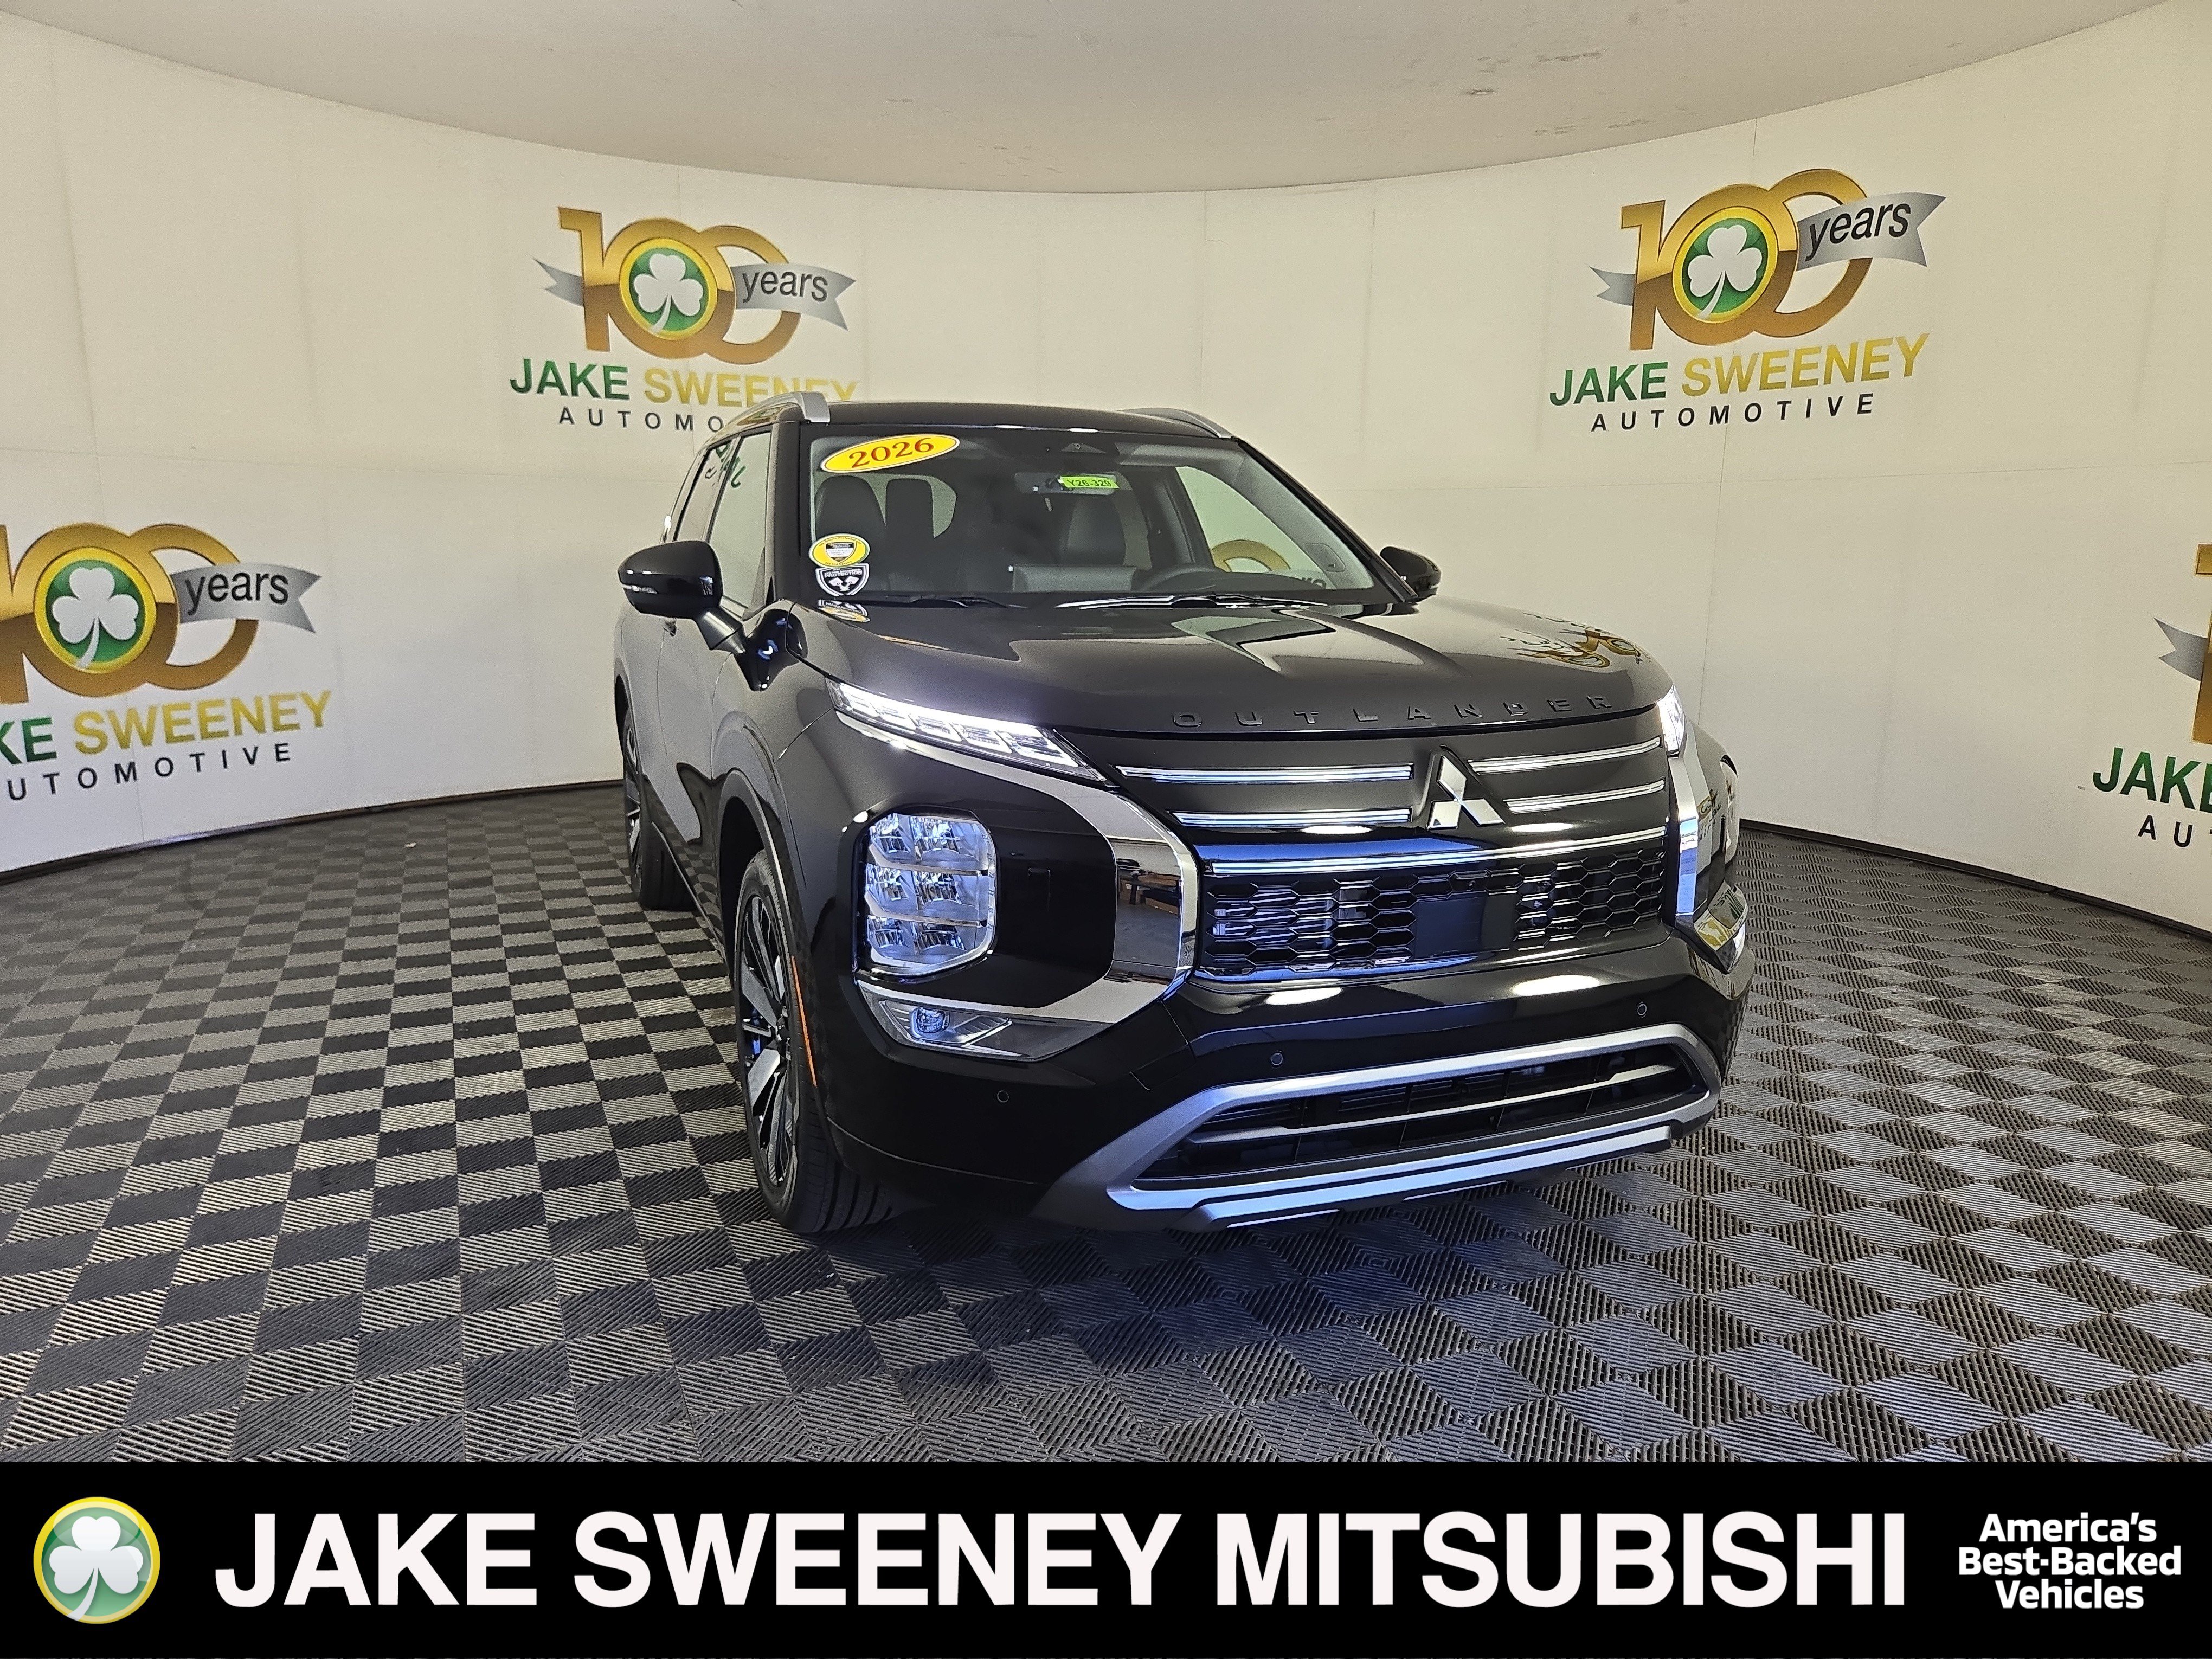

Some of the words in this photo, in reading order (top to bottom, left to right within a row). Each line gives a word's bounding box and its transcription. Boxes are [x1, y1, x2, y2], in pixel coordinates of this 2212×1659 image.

[1804, 201, 1911, 261] years
[742, 270, 828, 303] years
[510, 358, 630, 401] JAKE
[1549, 362, 1668, 406] JAKE
[1682, 332, 1931, 397] SWEENEY
[558, 407, 724, 432] AUTOMO
[1591, 393, 1874, 432] AUTOMOTIVE
[848, 437, 934, 469] 2026
[824, 569, 863, 578] PROTECTION
[184, 572, 289, 616] years
[0, 717, 57, 766] KE
[73, 691, 331, 755] SWEENEY
[1172, 695, 1612, 728] OUTLANDER
[7, 743, 291, 801] UTOMOTIVE
[2138, 814, 2212, 847] AU
